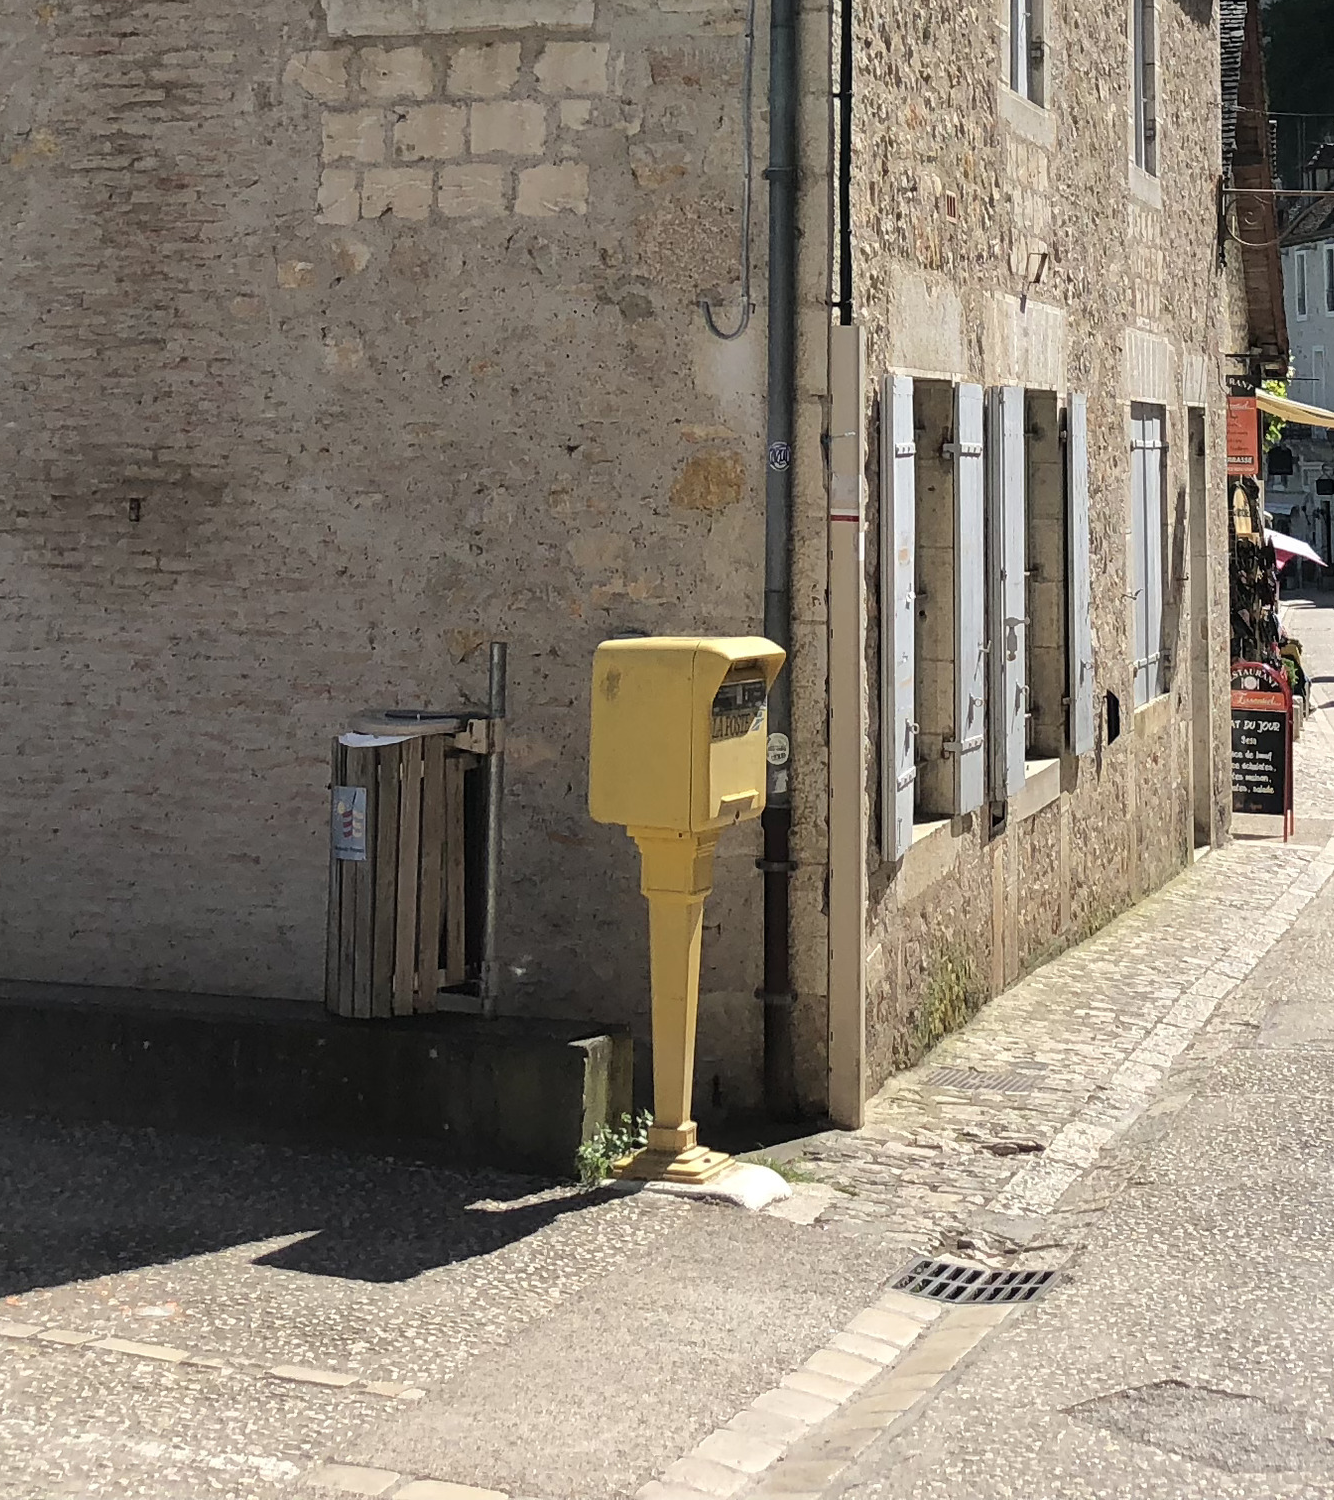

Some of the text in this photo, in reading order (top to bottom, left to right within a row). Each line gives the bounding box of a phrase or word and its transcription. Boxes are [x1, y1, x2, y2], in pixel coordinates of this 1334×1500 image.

[725, 712, 751, 737] POSTE
[1243, 720, 1256, 730] DU
[1257, 721, 1281, 733] JOUR
